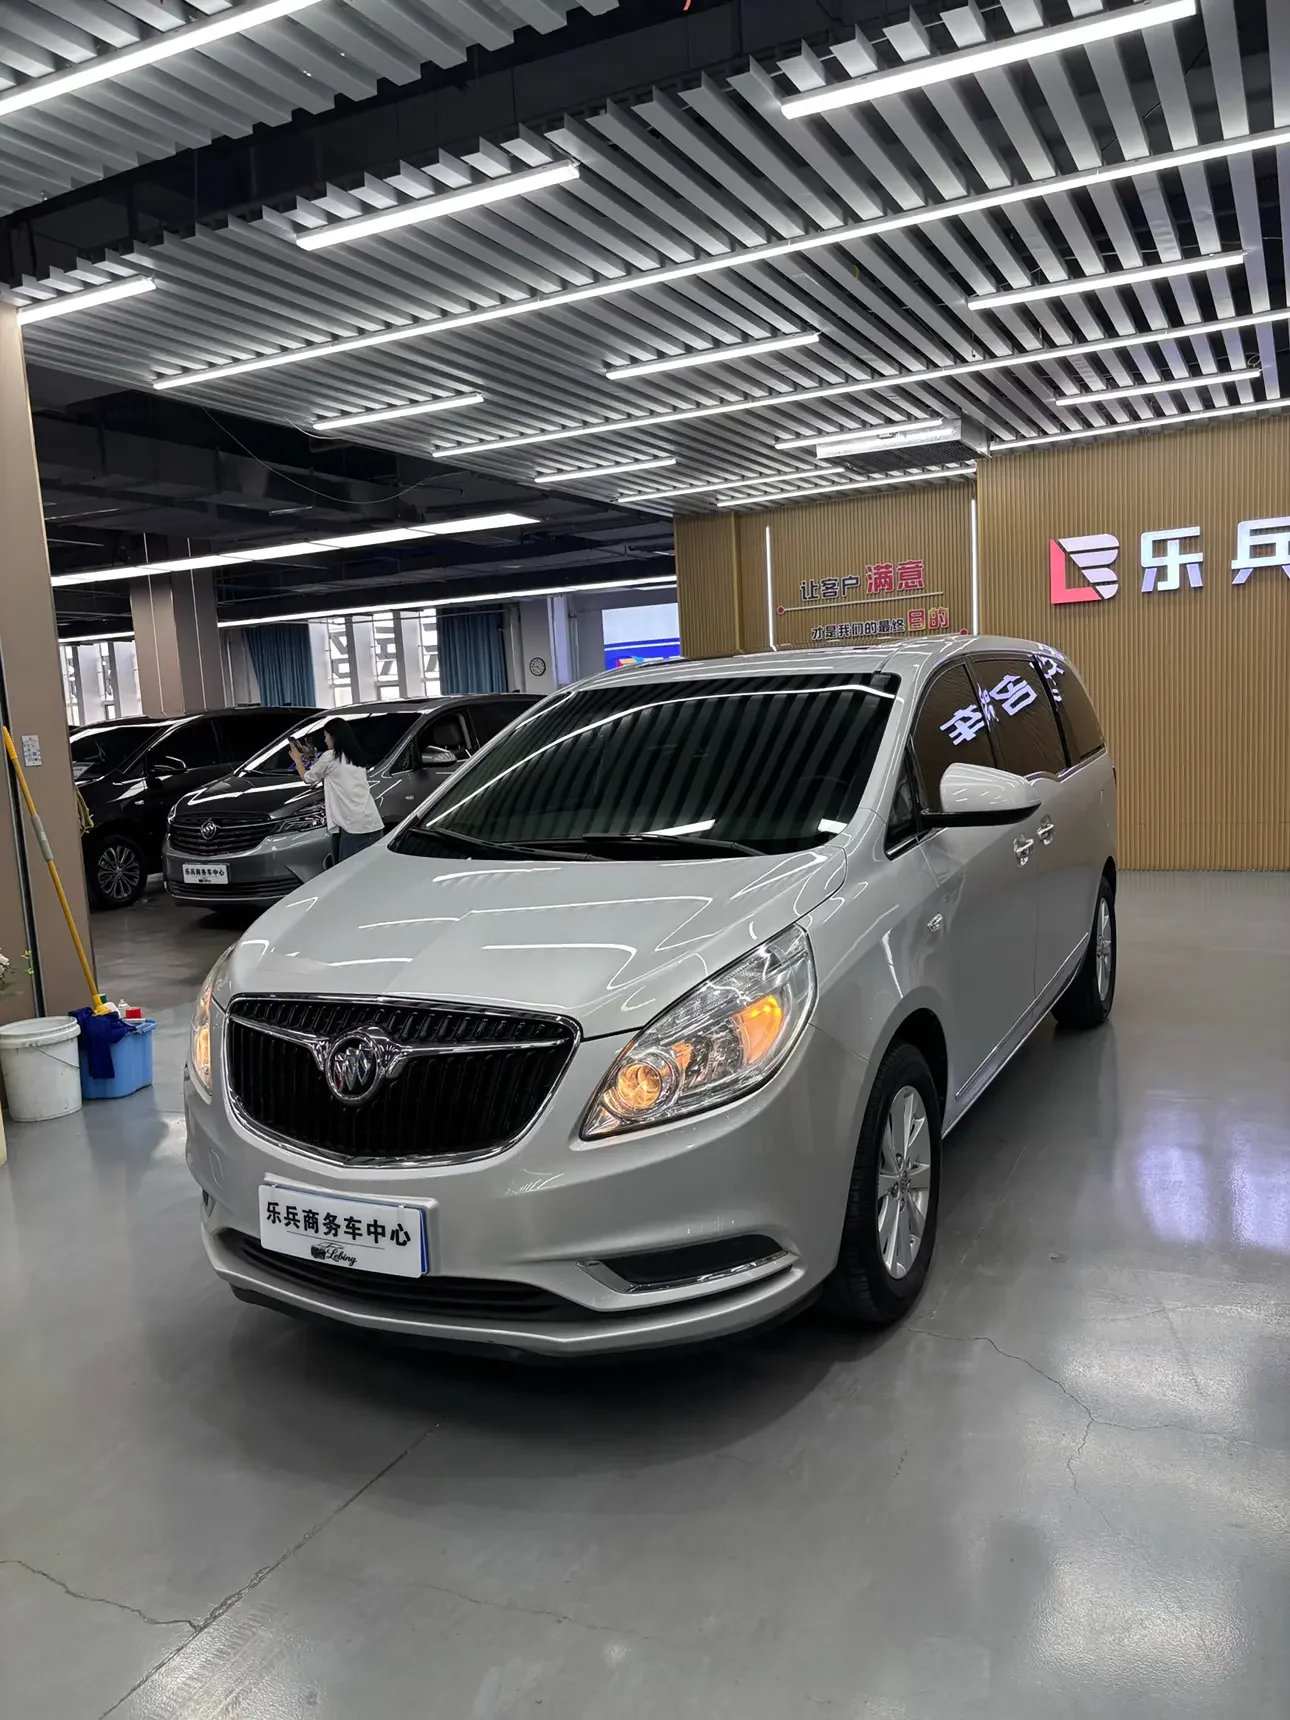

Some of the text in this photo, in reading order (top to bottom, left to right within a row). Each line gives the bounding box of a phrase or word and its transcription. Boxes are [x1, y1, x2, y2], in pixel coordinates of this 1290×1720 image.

[1140, 516, 1290, 592] 乐兵
[266, 1201, 411, 1247] 乐兵商务车中心
